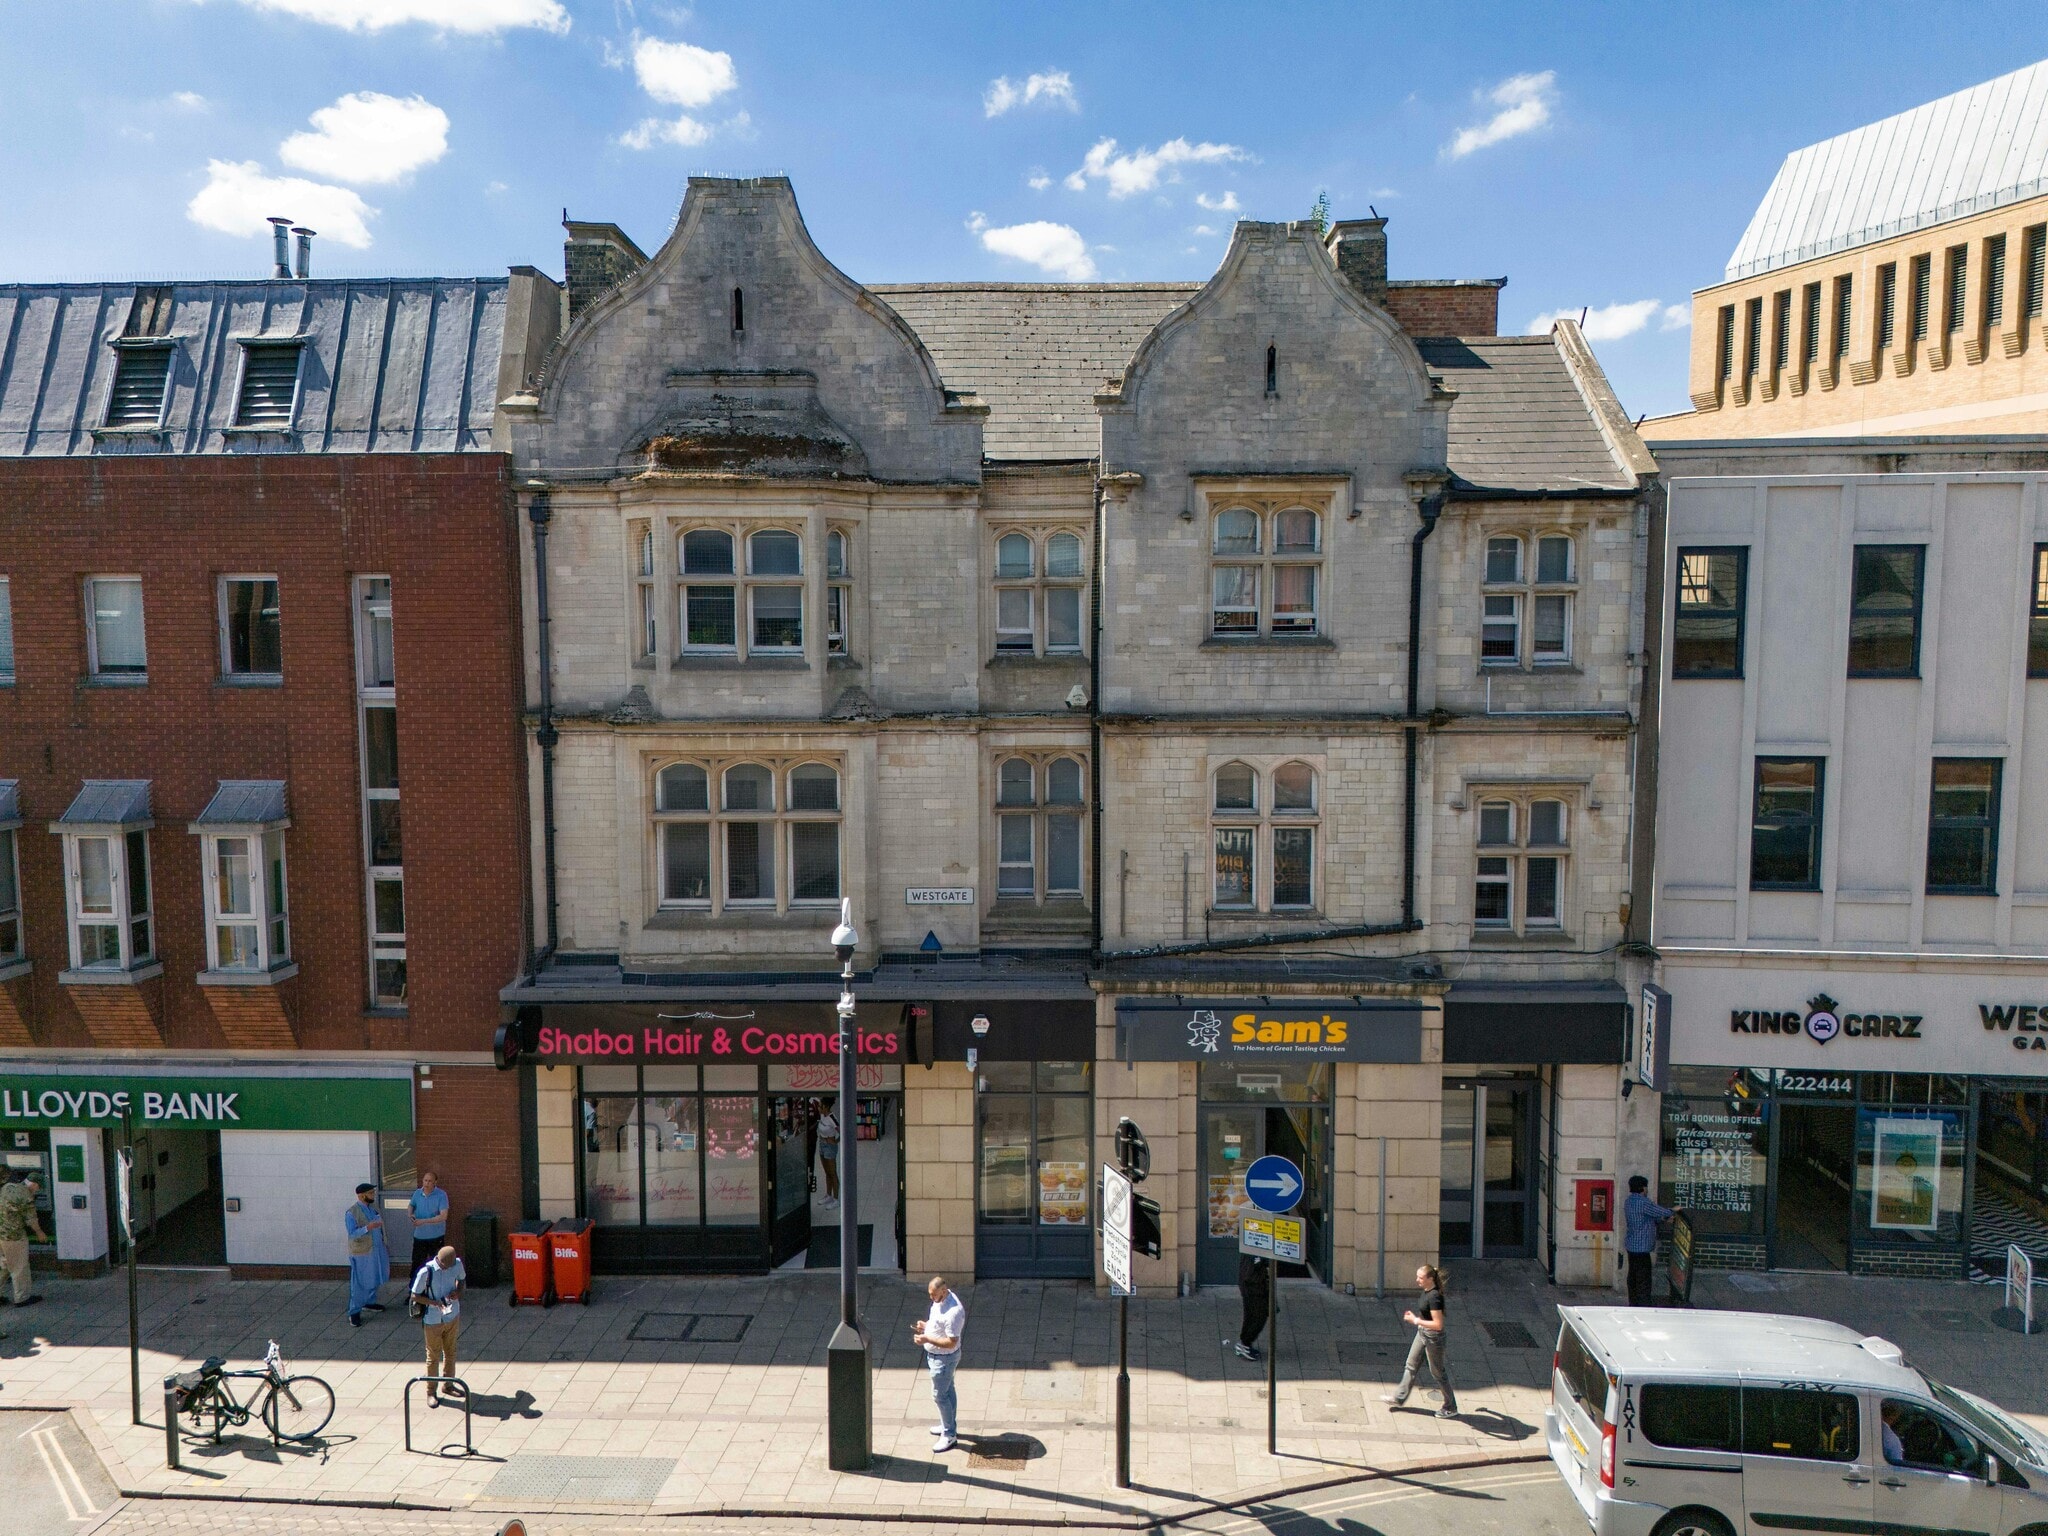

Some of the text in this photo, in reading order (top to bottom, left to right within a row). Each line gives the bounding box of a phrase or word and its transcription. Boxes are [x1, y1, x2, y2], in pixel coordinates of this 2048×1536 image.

[912, 892, 967, 900] WESTGATE
[911, 1007, 927, 1016] 33a
[1231, 1014, 1348, 1043] Sam's
[1730, 1010, 1923, 1038] KING CARZ
[538, 1028, 634, 1054] Shaba
[644, 1028, 702, 1054] Hair
[711, 1028, 732, 1054] &
[741, 1027, 898, 1055] Cosmeics
[1784, 1076, 1852, 1092] 222444
[4, 1090, 240, 1120] LLOYDS BANK
[1668, 1114, 1762, 1124] TAXI BOOKING OFFICE
[1676, 1128, 1752, 1139] Taksometrs
[1684, 1148, 1740, 1168] TAXI
[1704, 1168, 1740, 1180] teksi
[1724, 1202, 1751, 1212] TAXI
[514, 1249, 538, 1260] Biffa
[554, 1248, 578, 1258] Biffa
[1106, 1260, 1127, 1286] ENDS
[1623, 1384, 1636, 1443] TAXI
